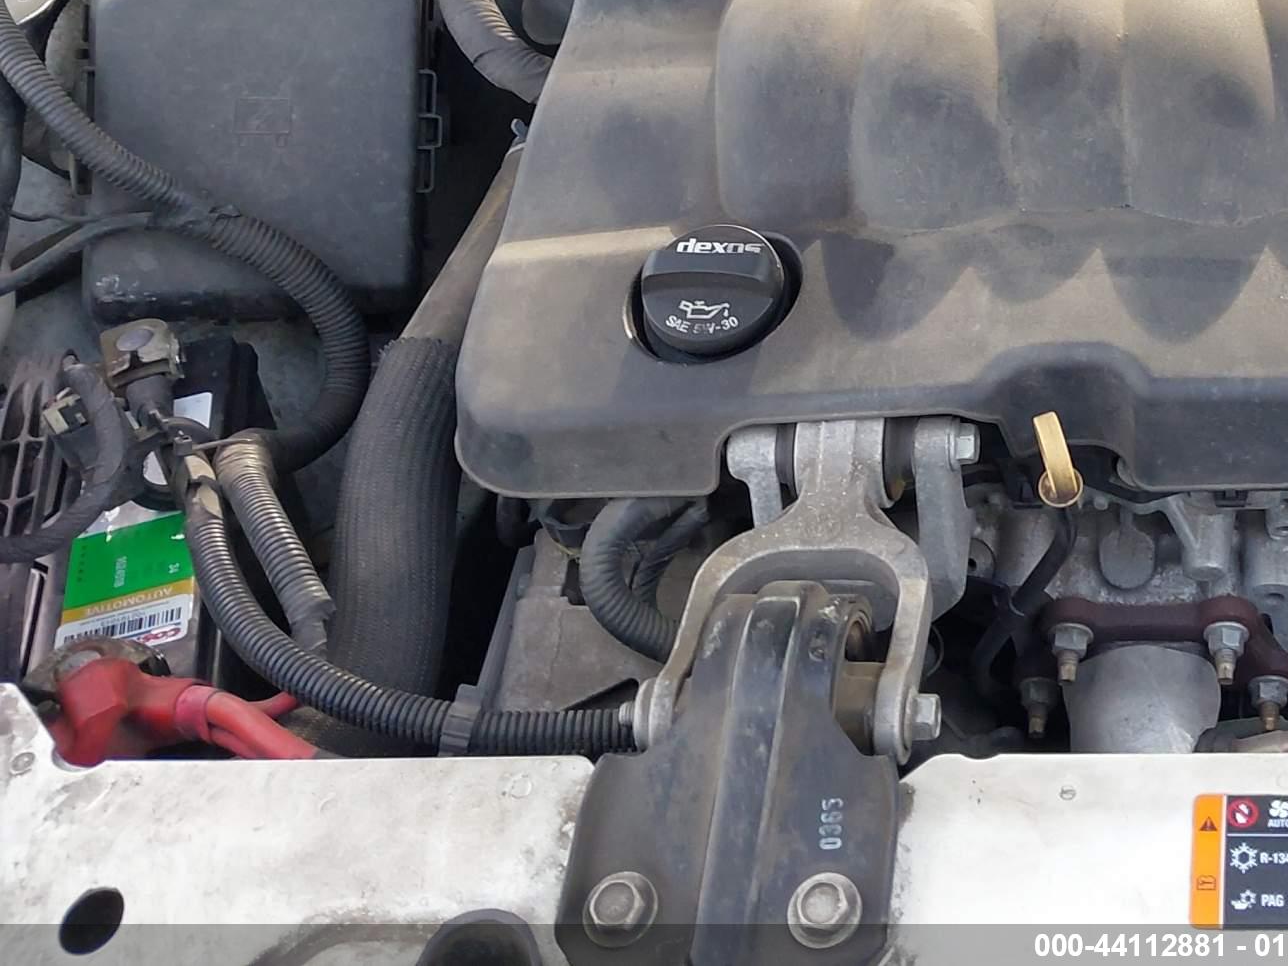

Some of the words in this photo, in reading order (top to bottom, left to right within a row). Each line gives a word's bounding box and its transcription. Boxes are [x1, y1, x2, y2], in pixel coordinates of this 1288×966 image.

[676, 238, 765, 254] dexos
[665, 315, 691, 333] SAE
[84, 587, 173, 616] AUTOMOTIVE
[1261, 894, 1285, 907] PAG
